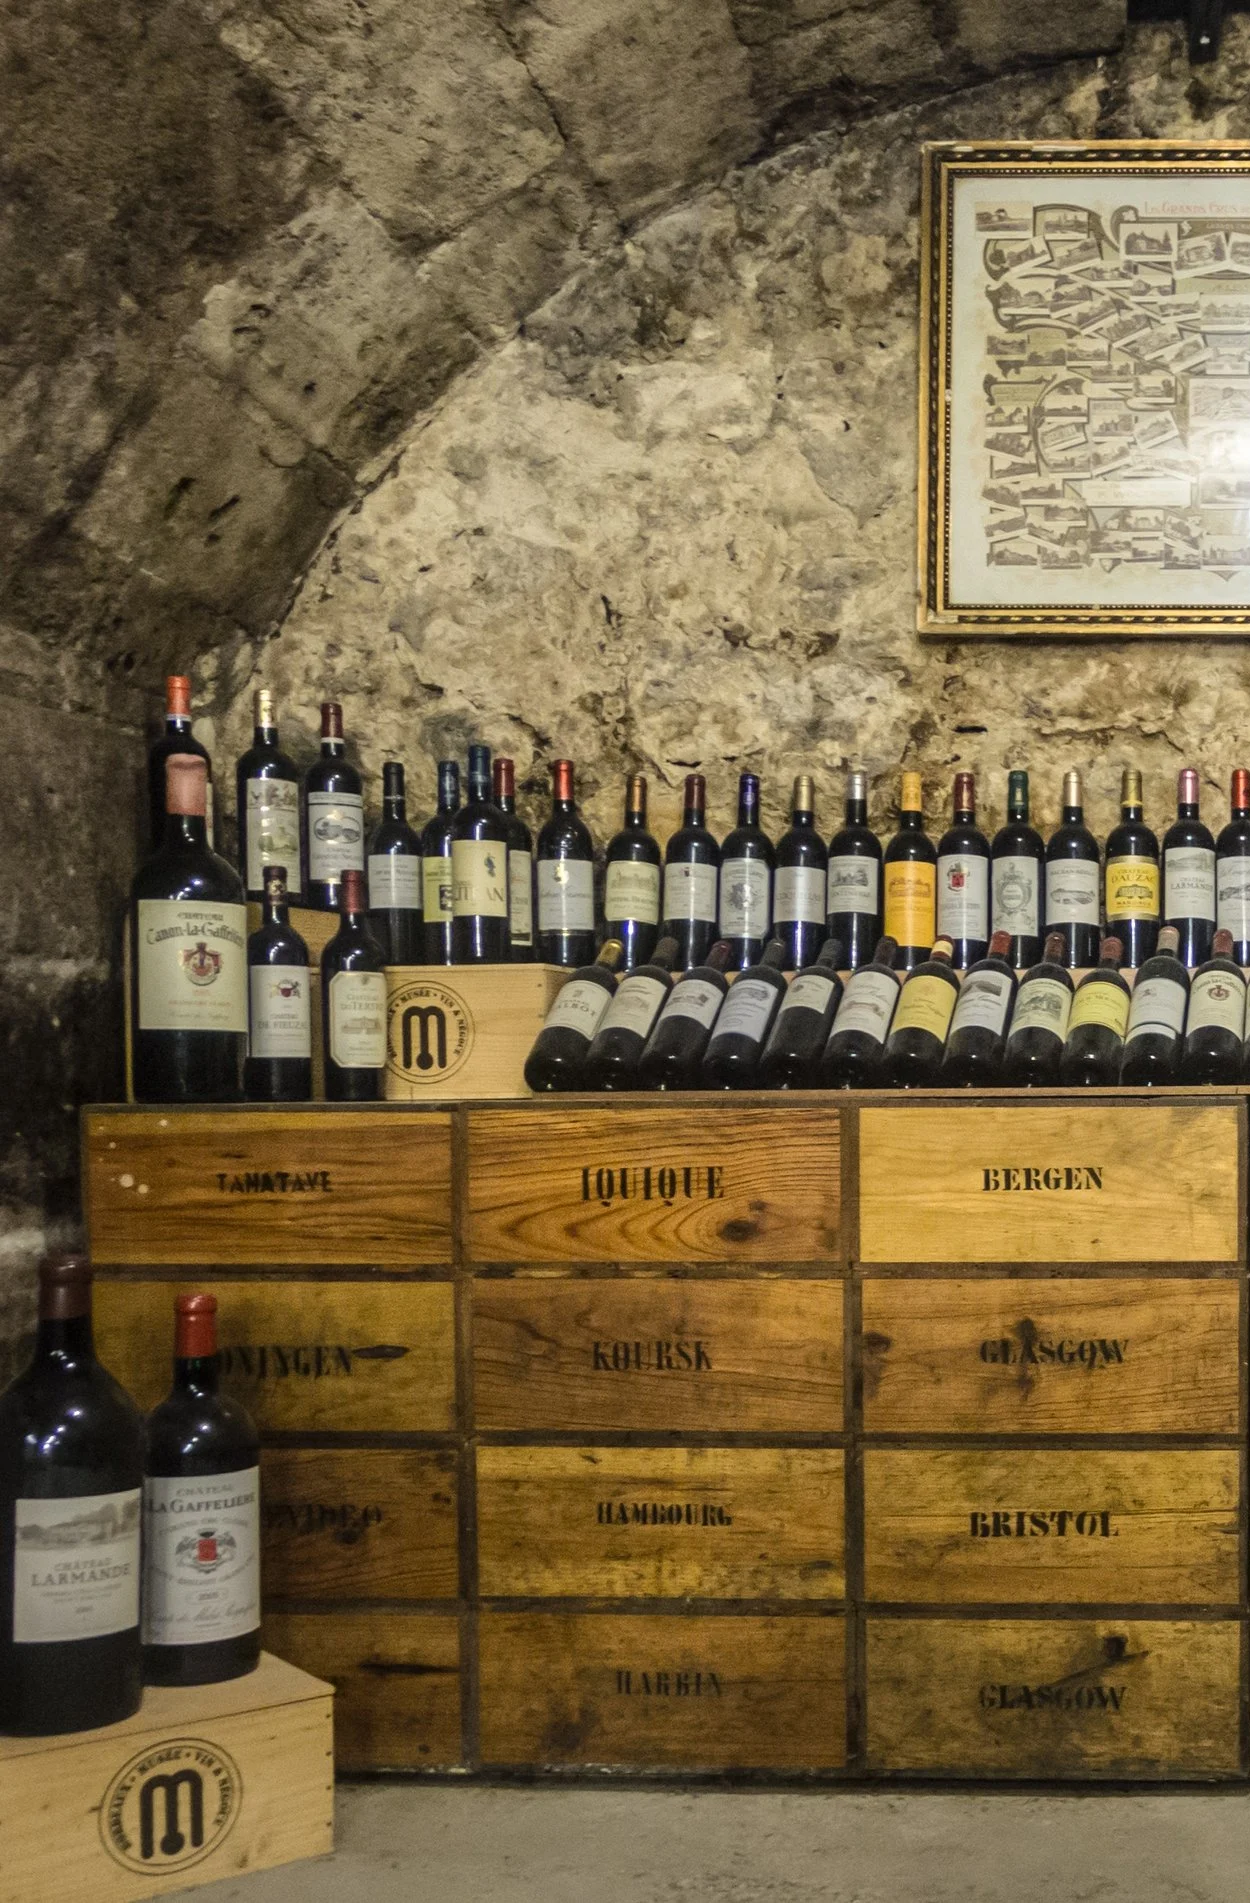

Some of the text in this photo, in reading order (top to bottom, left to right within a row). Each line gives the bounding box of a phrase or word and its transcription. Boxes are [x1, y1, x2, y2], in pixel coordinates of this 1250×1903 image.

[982, 1167, 1104, 1192] BERGEN
[592, 1341, 713, 1371] KOURSK
[969, 1511, 1120, 1538] BRISTOL
[31, 1563, 132, 1586] LARMANDE
[979, 1685, 1128, 1710] GLASGOW
